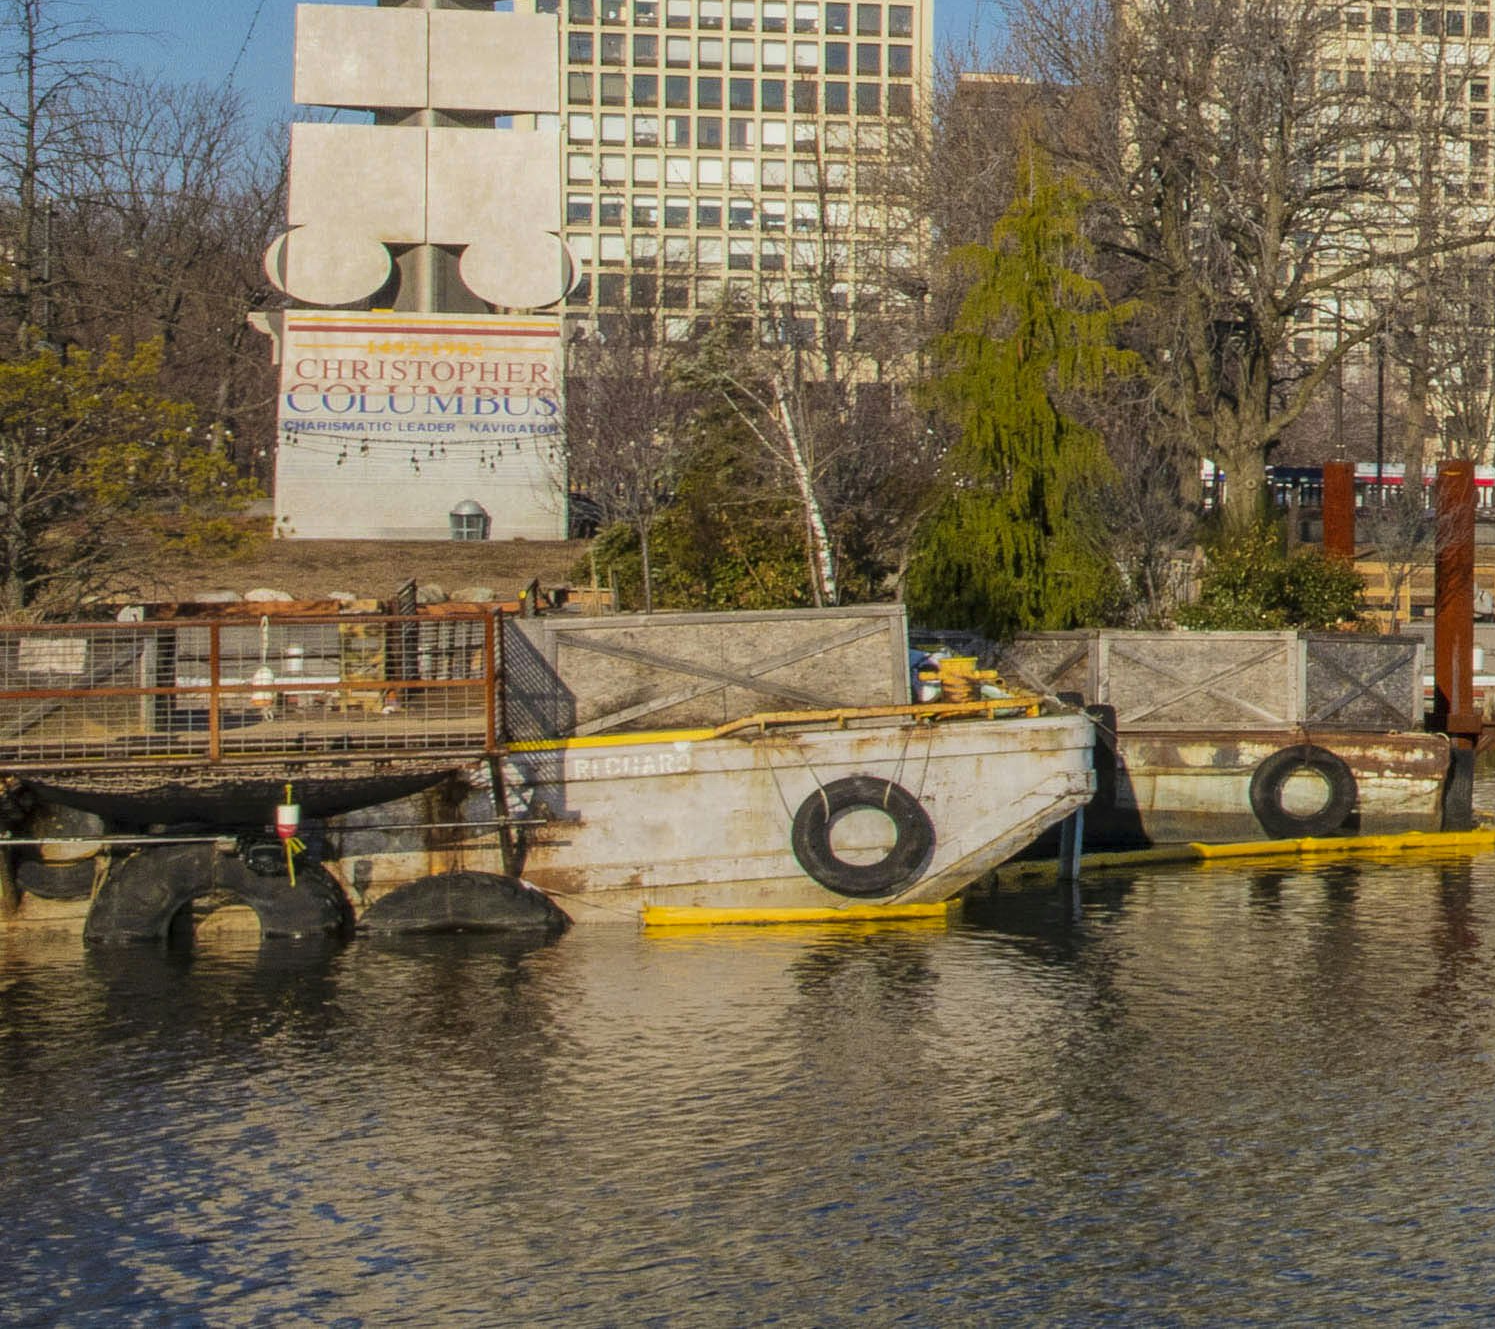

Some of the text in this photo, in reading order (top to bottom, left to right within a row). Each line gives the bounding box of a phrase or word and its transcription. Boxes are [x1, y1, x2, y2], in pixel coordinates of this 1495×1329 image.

[295, 357, 552, 384] CHRISTOPHER
[285, 383, 560, 417] COLUMBUS
[283, 420, 558, 434] CHARISMATIC LEADER NAVIGATOR
